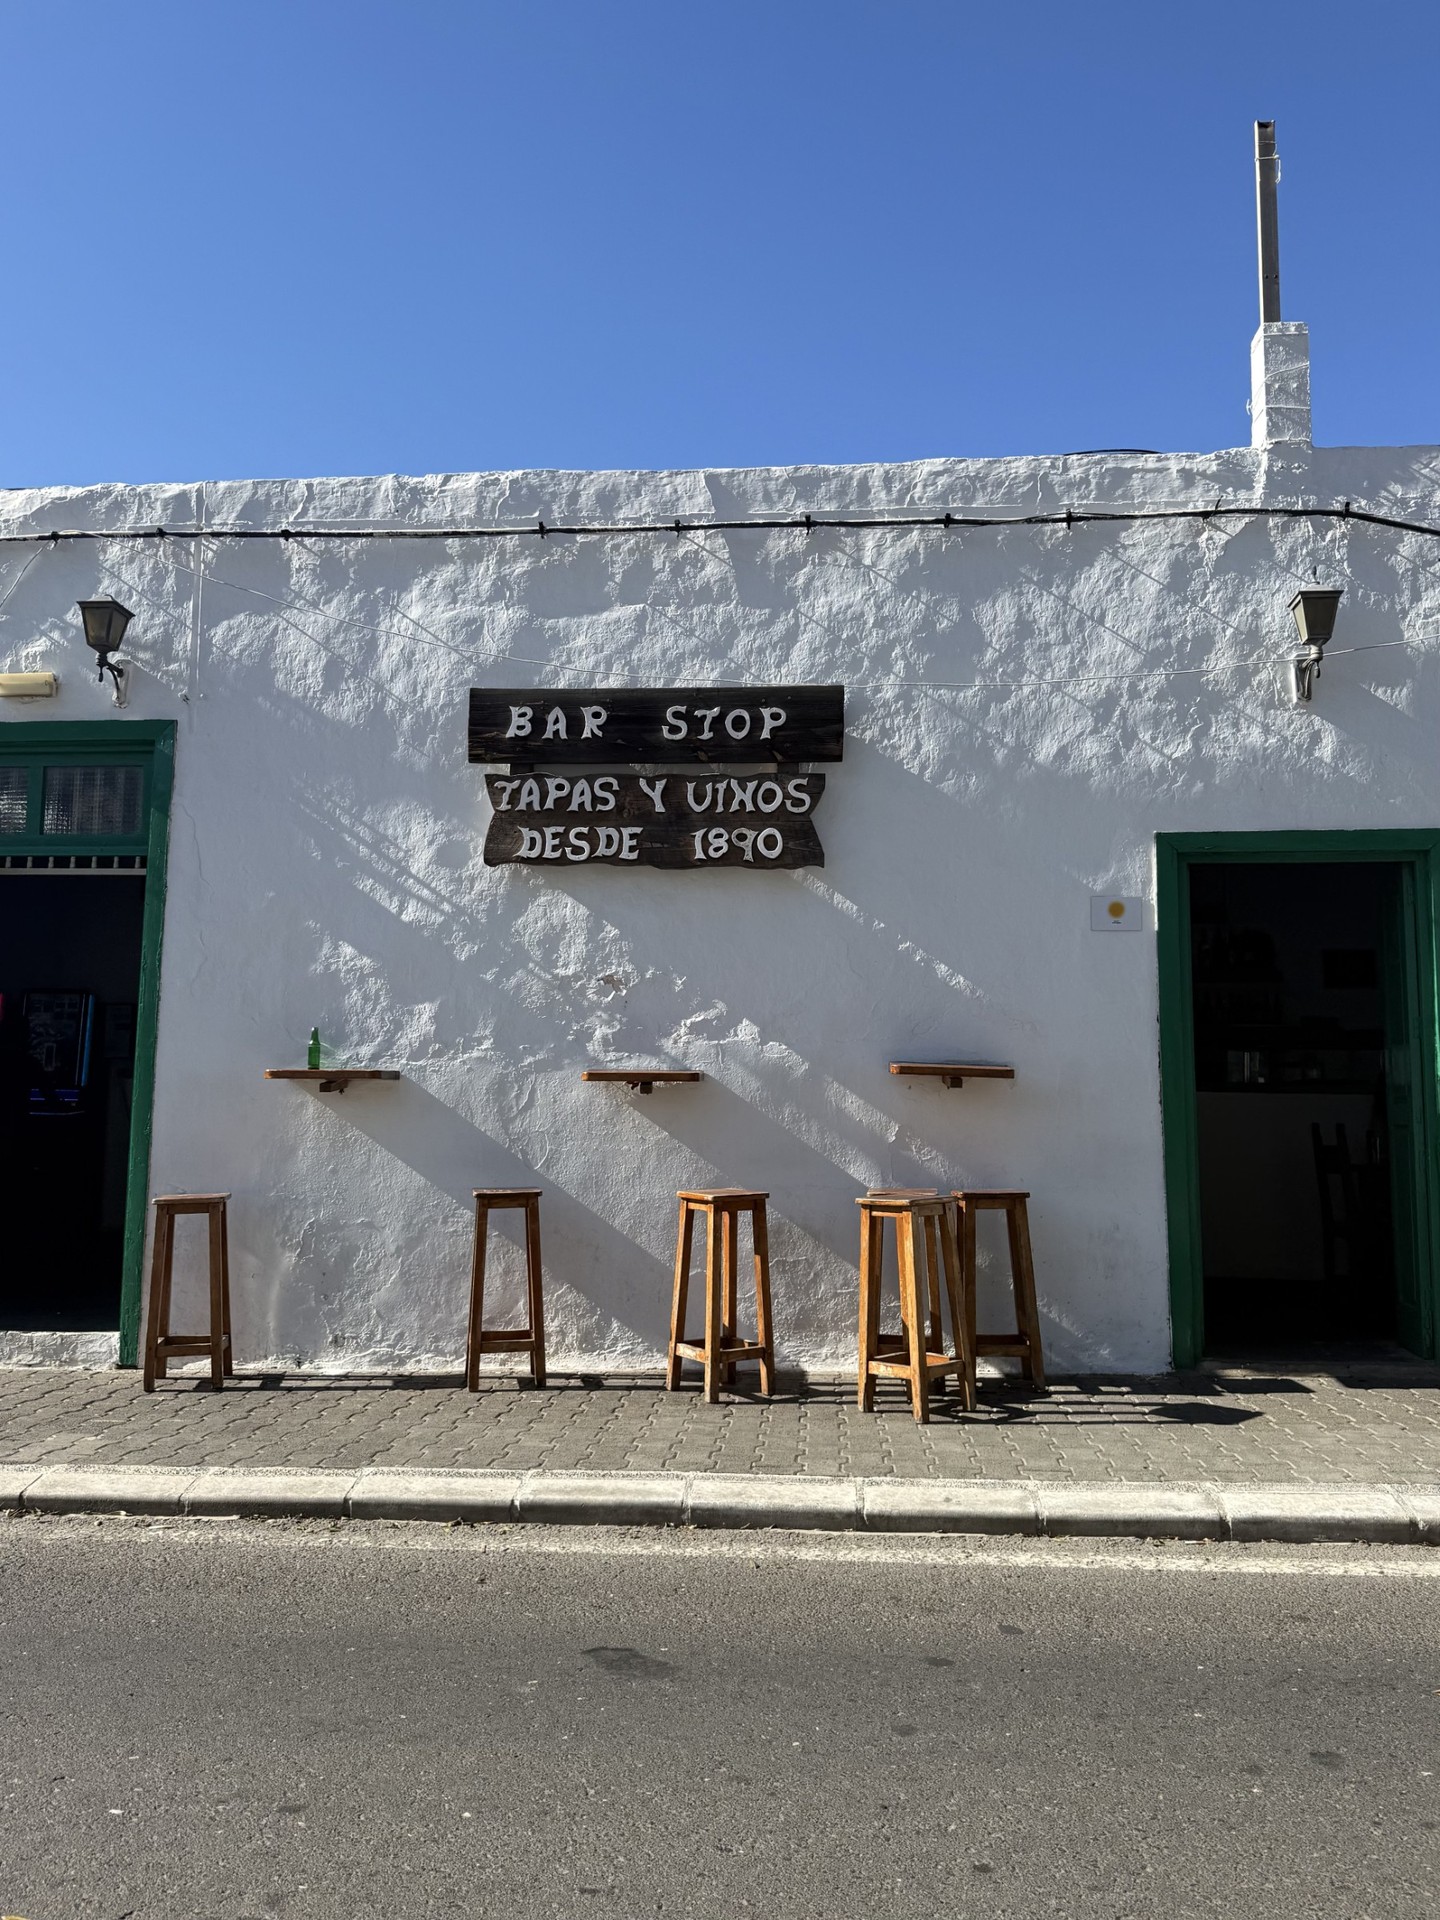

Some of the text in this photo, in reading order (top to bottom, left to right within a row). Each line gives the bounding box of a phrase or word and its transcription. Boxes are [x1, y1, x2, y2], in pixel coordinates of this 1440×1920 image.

[505, 705, 787, 741] BAR STOP
[494, 777, 620, 813] TAPAS
[639, 777, 668, 813] Y
[513, 825, 784, 862] DESDE 1890
